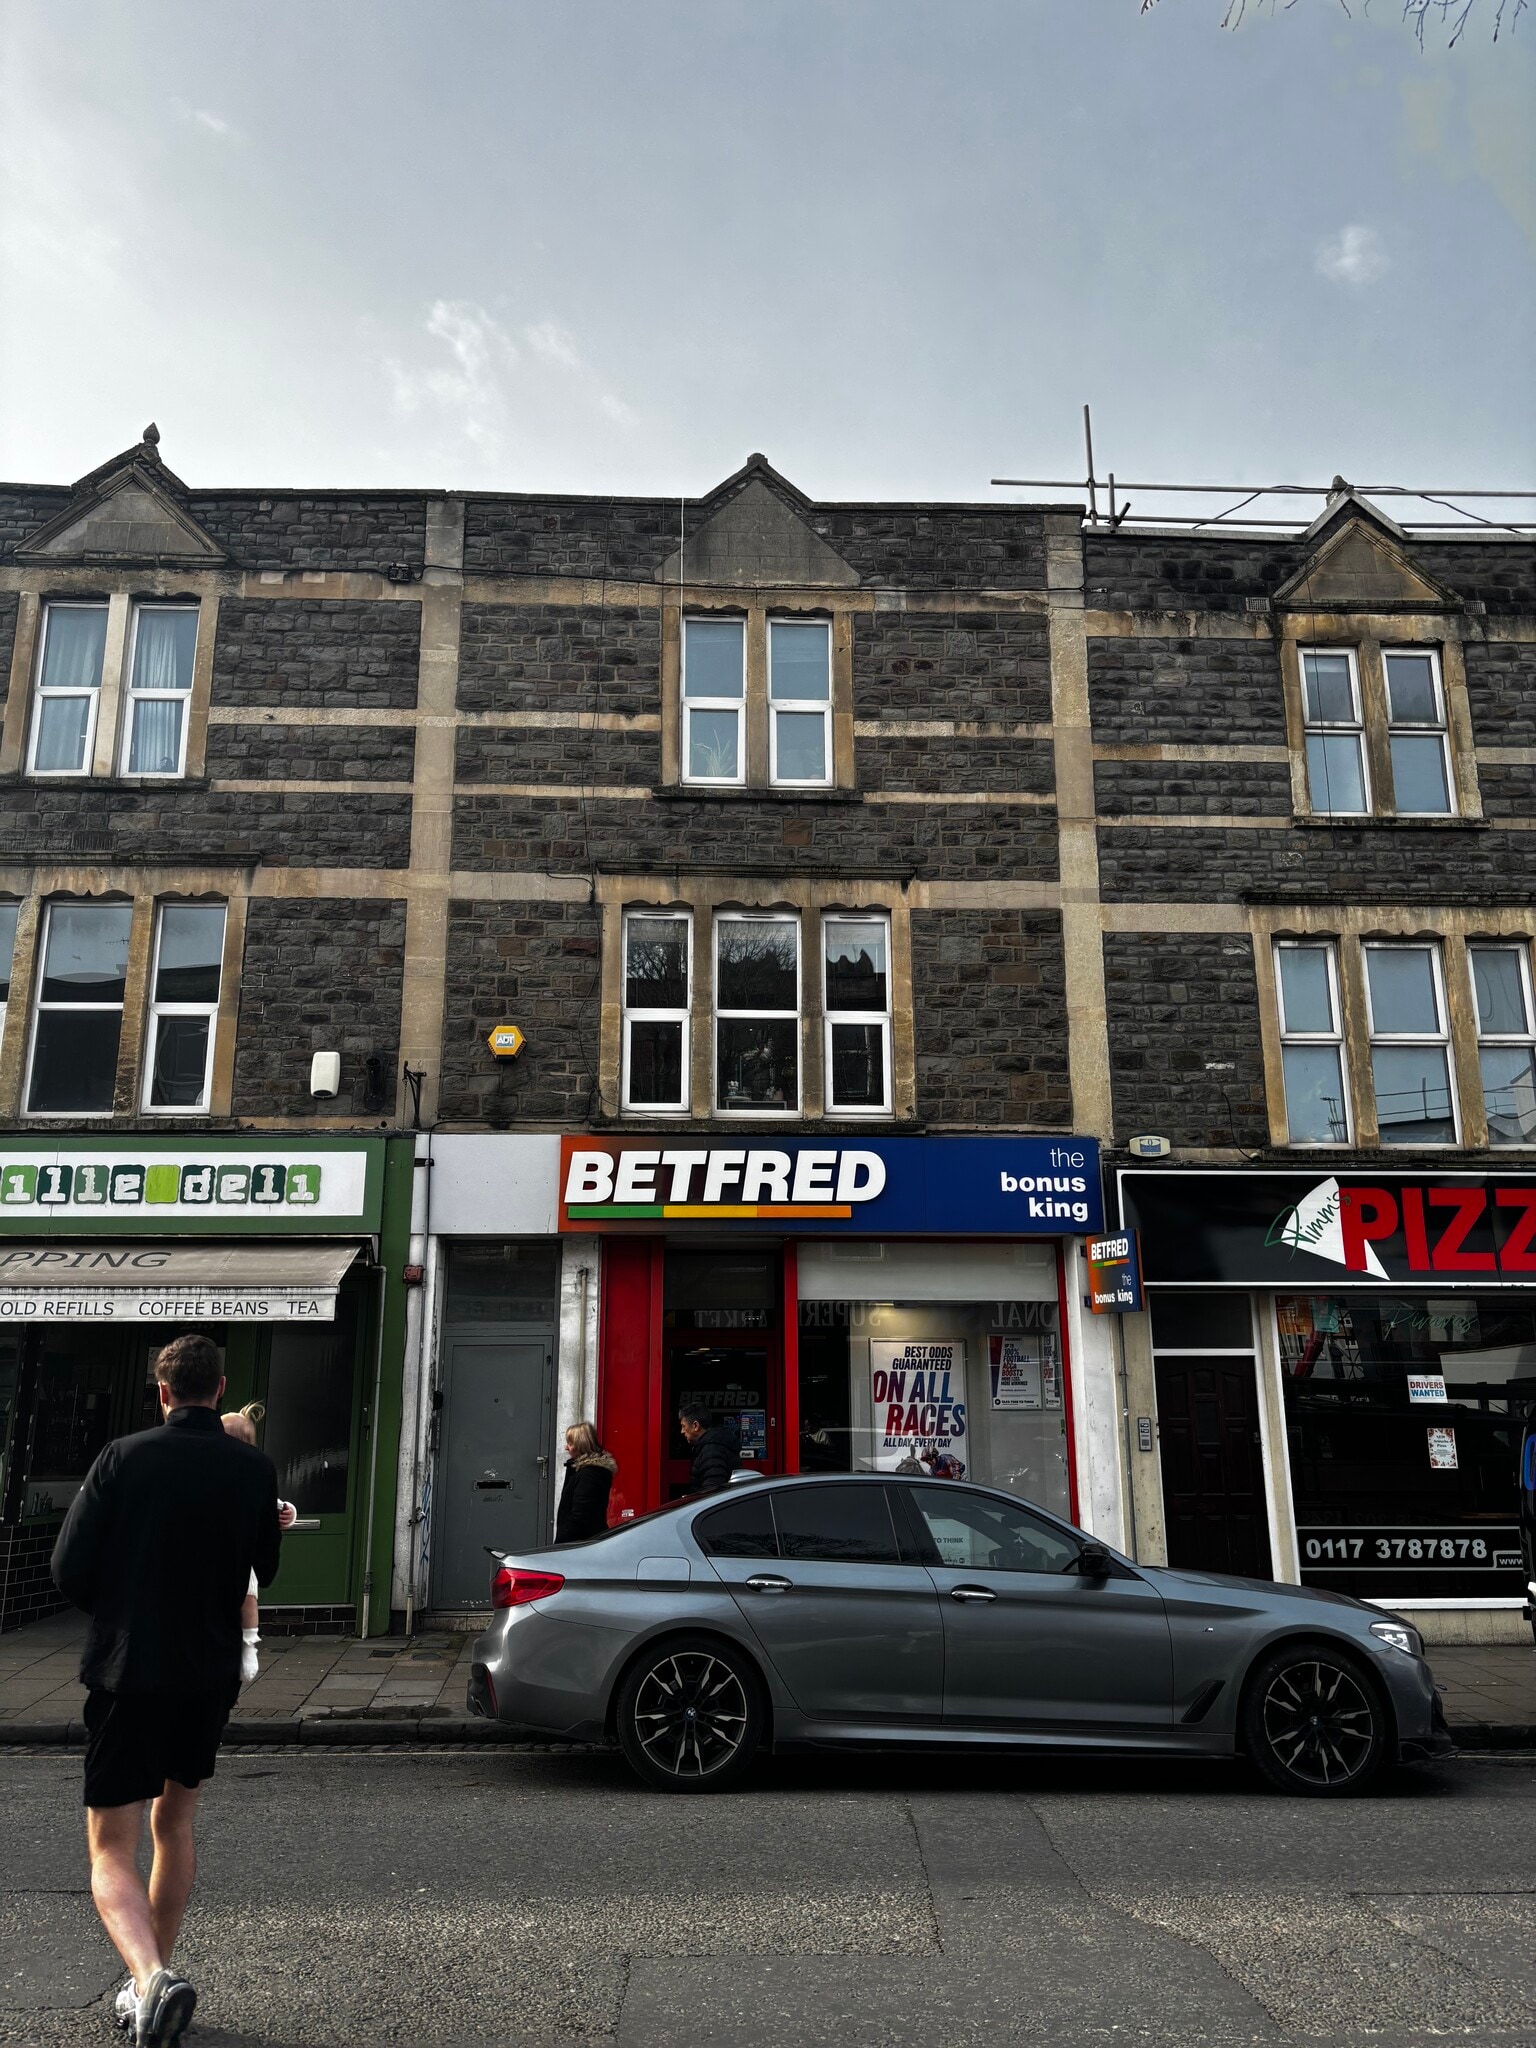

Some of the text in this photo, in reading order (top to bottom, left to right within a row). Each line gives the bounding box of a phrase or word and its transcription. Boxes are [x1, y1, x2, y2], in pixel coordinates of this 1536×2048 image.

[496, 1035, 514, 1045] ADT
[1049, 1147, 1085, 1168] the
[564, 1150, 887, 1203] BETFRED
[1000, 1171, 1087, 1193] bonus
[1028, 1197, 1089, 1223] king
[1338, 1186, 1536, 1272] PIZZ
[1090, 1237, 1130, 1261] BETFRED
[0, 1251, 172, 1269] PPING
[1121, 1272, 1132, 1287] the
[1094, 1288, 1134, 1305] bonus king
[0, 1301, 319, 1316] OLD REFILLS COFFEE BEANS TEA
[904, 1346, 954, 1359] BEST ODDS
[892, 1358, 952, 1371] GUARANTEED
[873, 1370, 954, 1403] ON ALL
[1409, 1381, 1444, 1389] DRIVERS
[1411, 1389, 1445, 1397] WANTED
[679, 1391, 760, 1407] BETFRED
[885, 1403, 965, 1437] RACES
[882, 1437, 897, 1448] ALL
[914, 1437, 938, 1448] EVERY
[938, 1437, 952, 1448] DAY
[1306, 1539, 1487, 1559] 0117 3787878
